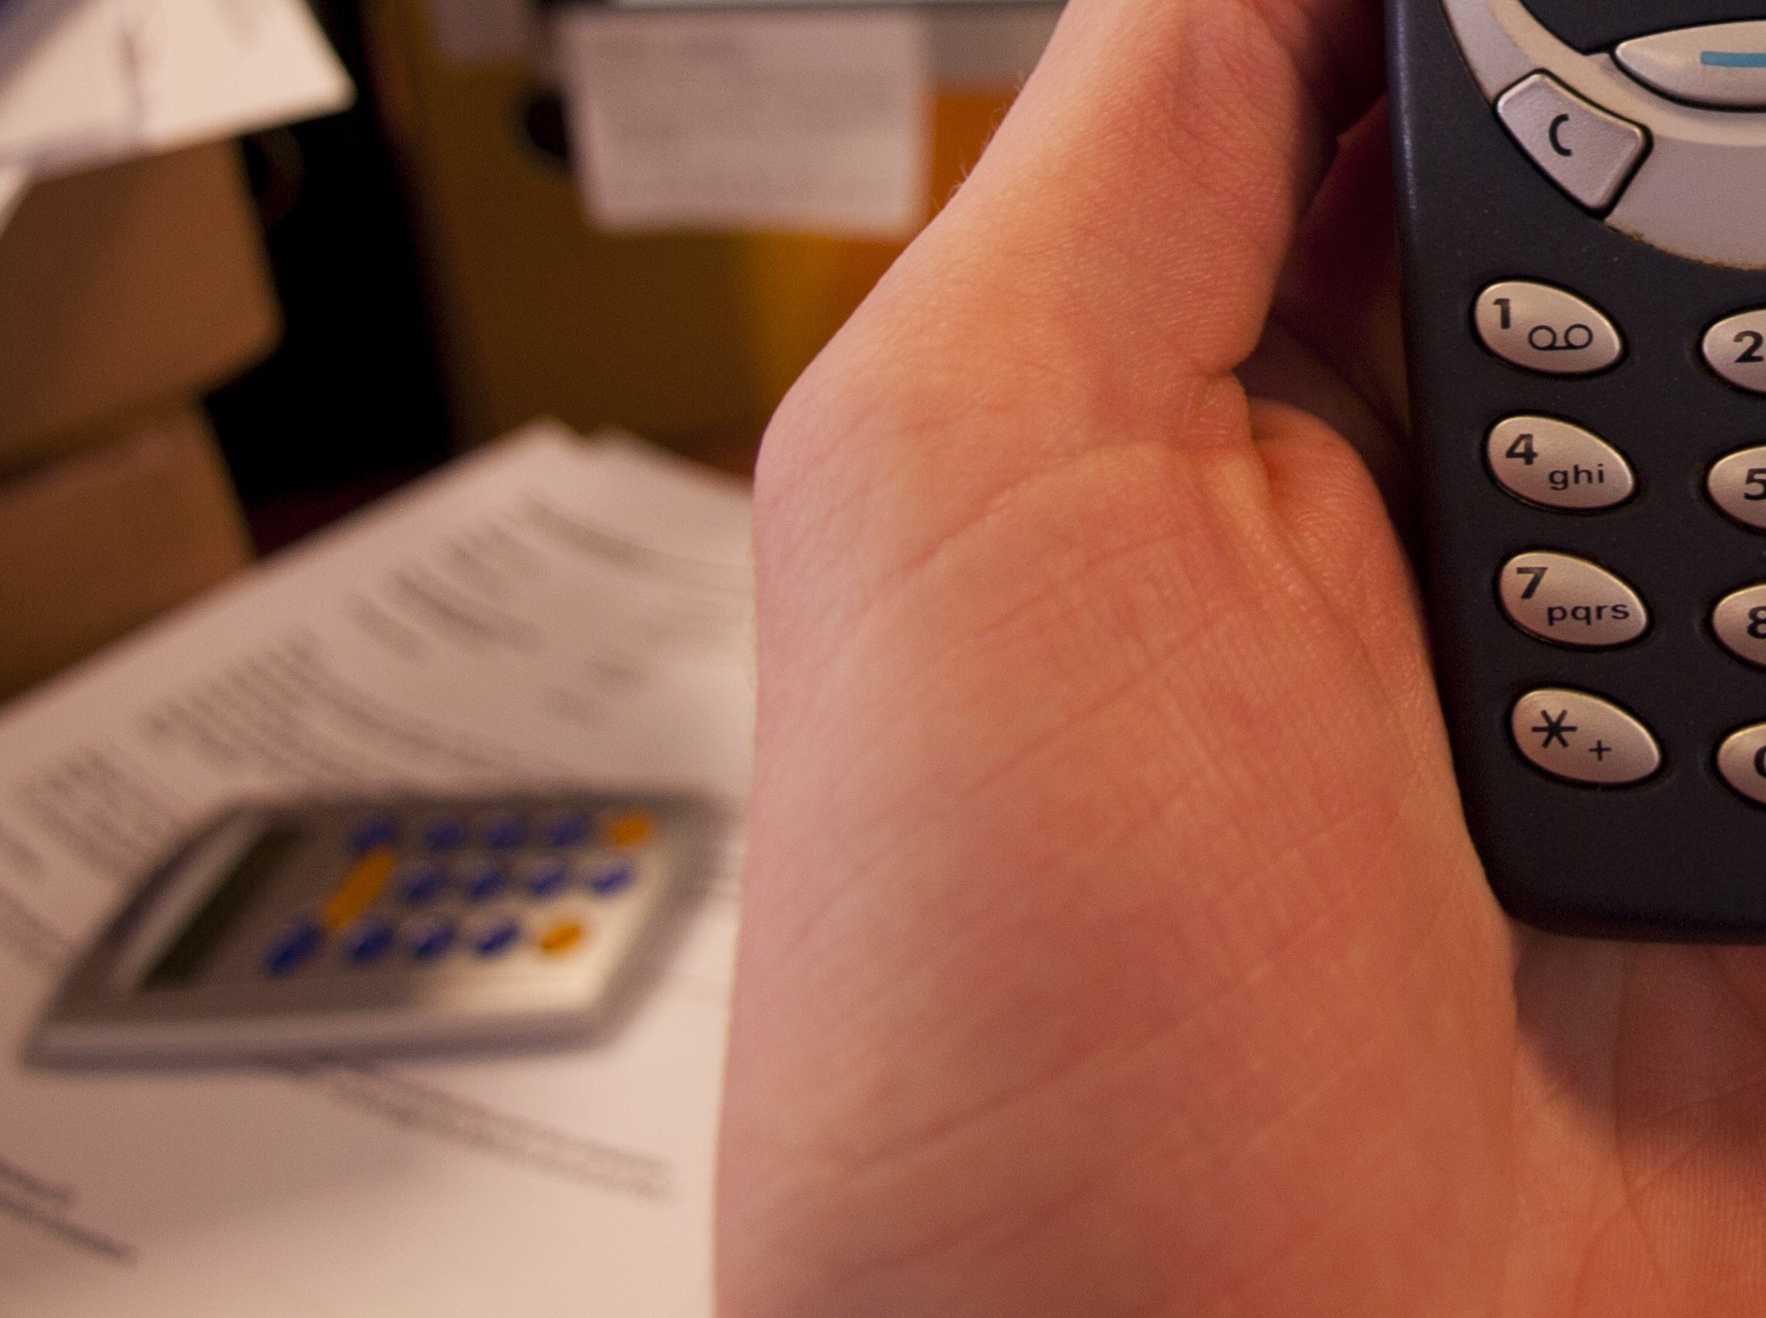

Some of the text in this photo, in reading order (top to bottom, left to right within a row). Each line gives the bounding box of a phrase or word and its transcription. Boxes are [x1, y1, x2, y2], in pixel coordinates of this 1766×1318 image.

[1493, 298, 1512, 330] 1
[1734, 330, 1765, 364] 2
[1504, 433, 1605, 492] 4 ghi
[1516, 567, 1630, 628] 7 pqrs
